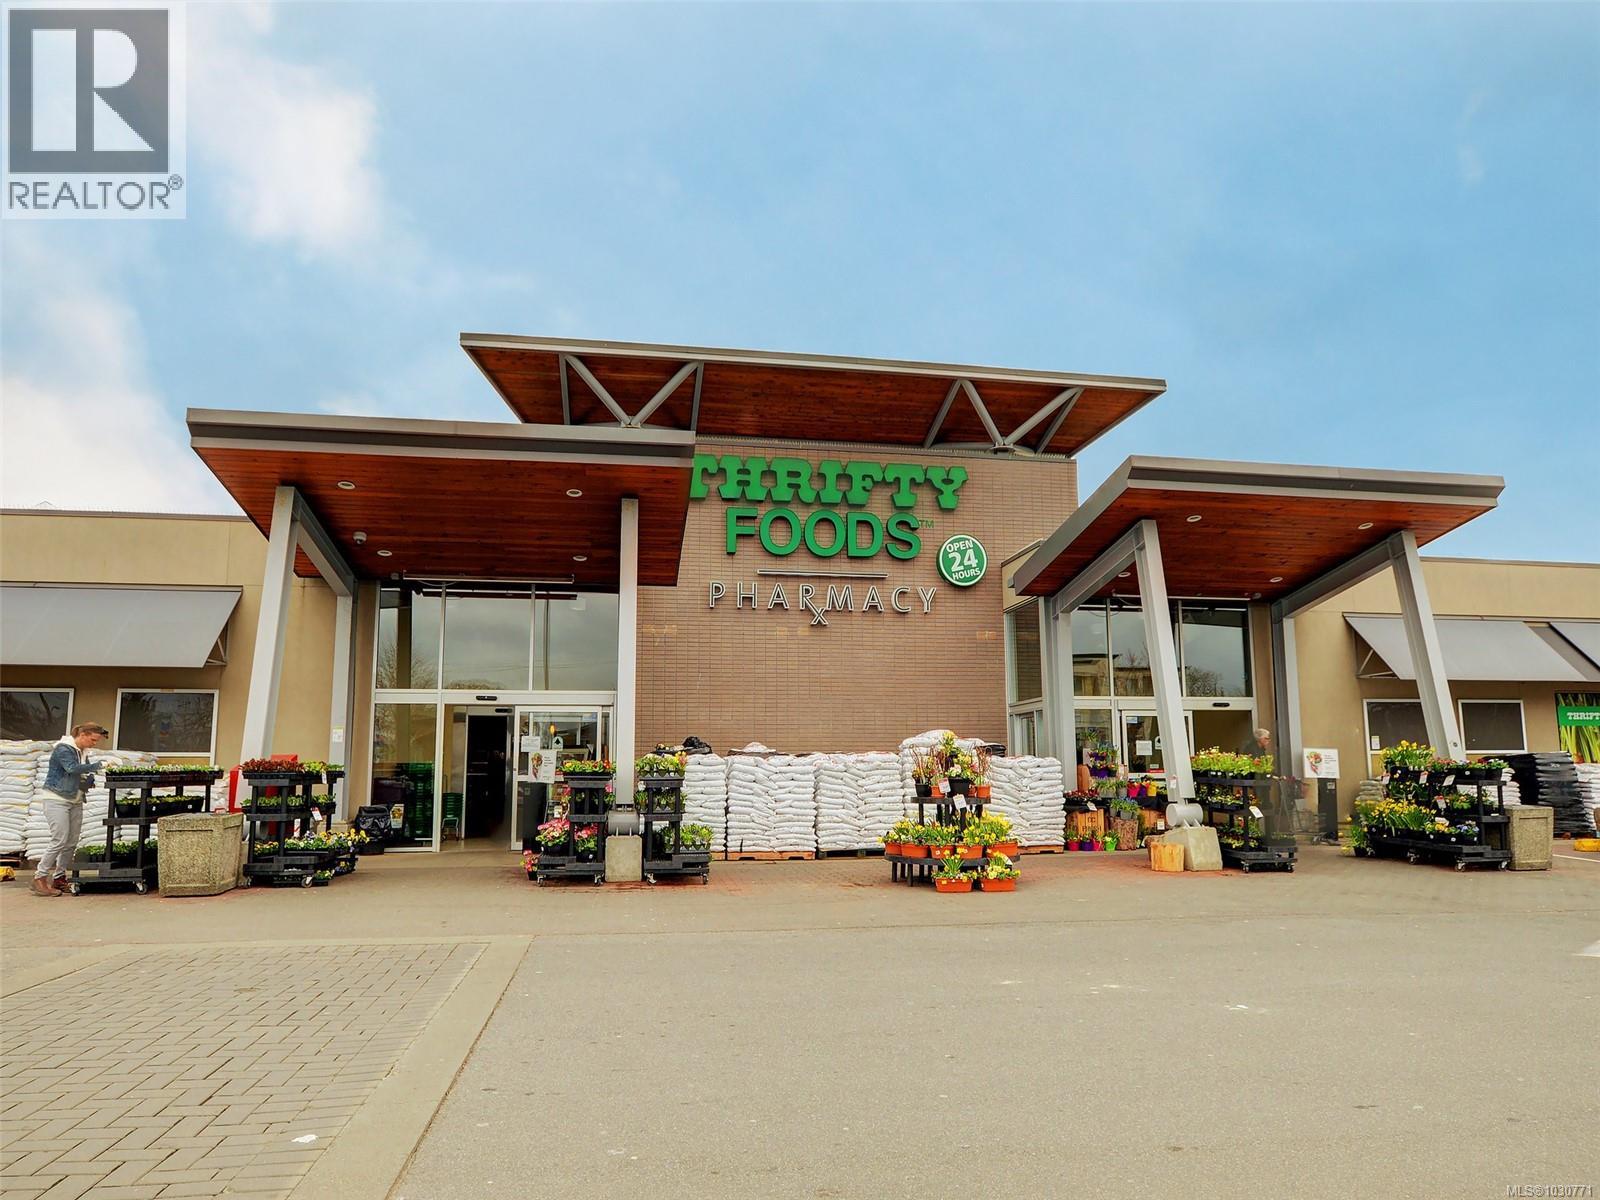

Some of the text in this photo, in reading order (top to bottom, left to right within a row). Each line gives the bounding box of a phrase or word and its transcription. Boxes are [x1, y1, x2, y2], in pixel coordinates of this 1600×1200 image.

[689, 453, 969, 510] THRIFTY
[946, 539, 974, 553] OPEN
[948, 548, 979, 572] 24
[952, 567, 981, 581] HOURS
[709, 581, 937, 626] PHARMACY
